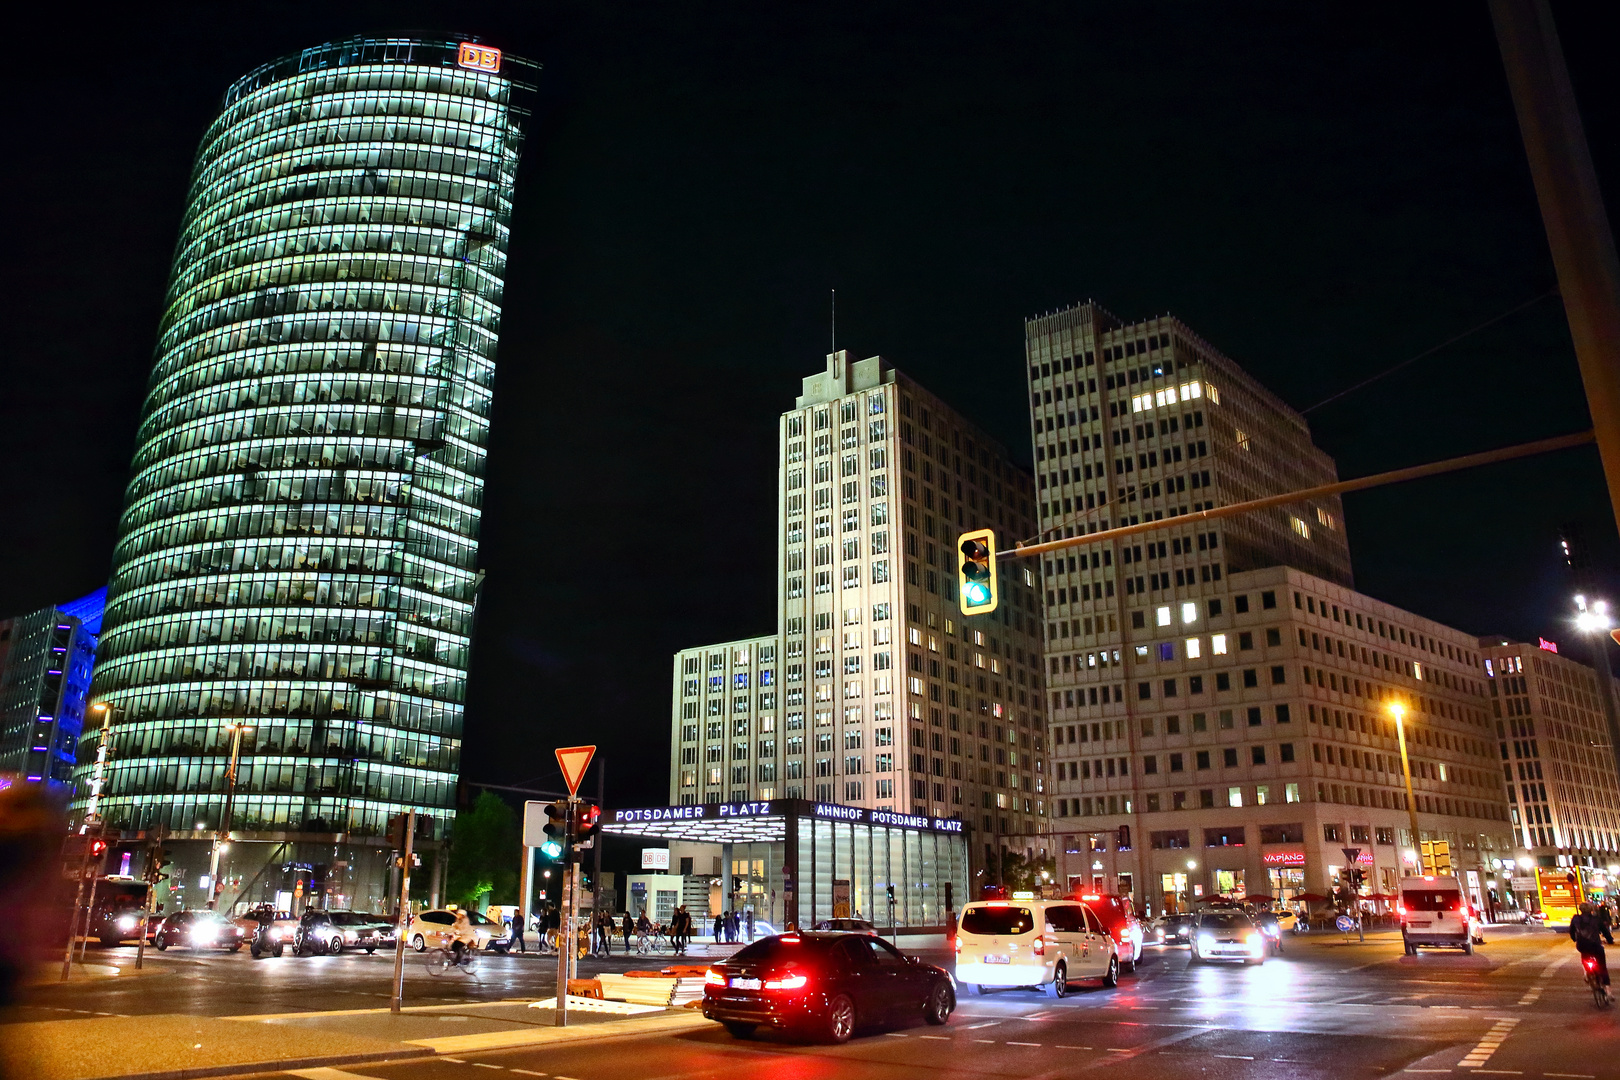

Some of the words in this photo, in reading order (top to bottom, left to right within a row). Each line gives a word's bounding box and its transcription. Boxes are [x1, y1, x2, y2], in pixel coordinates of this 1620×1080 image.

[463, 47, 497, 68] DB
[615, 806, 703, 821] POTSDAMER
[719, 802, 770, 817] PLATZ
[872, 811, 928, 828] POTSDAMER
[936, 819, 962, 832] PLATZ
[1264, 853, 1304, 862] VAPIANO
